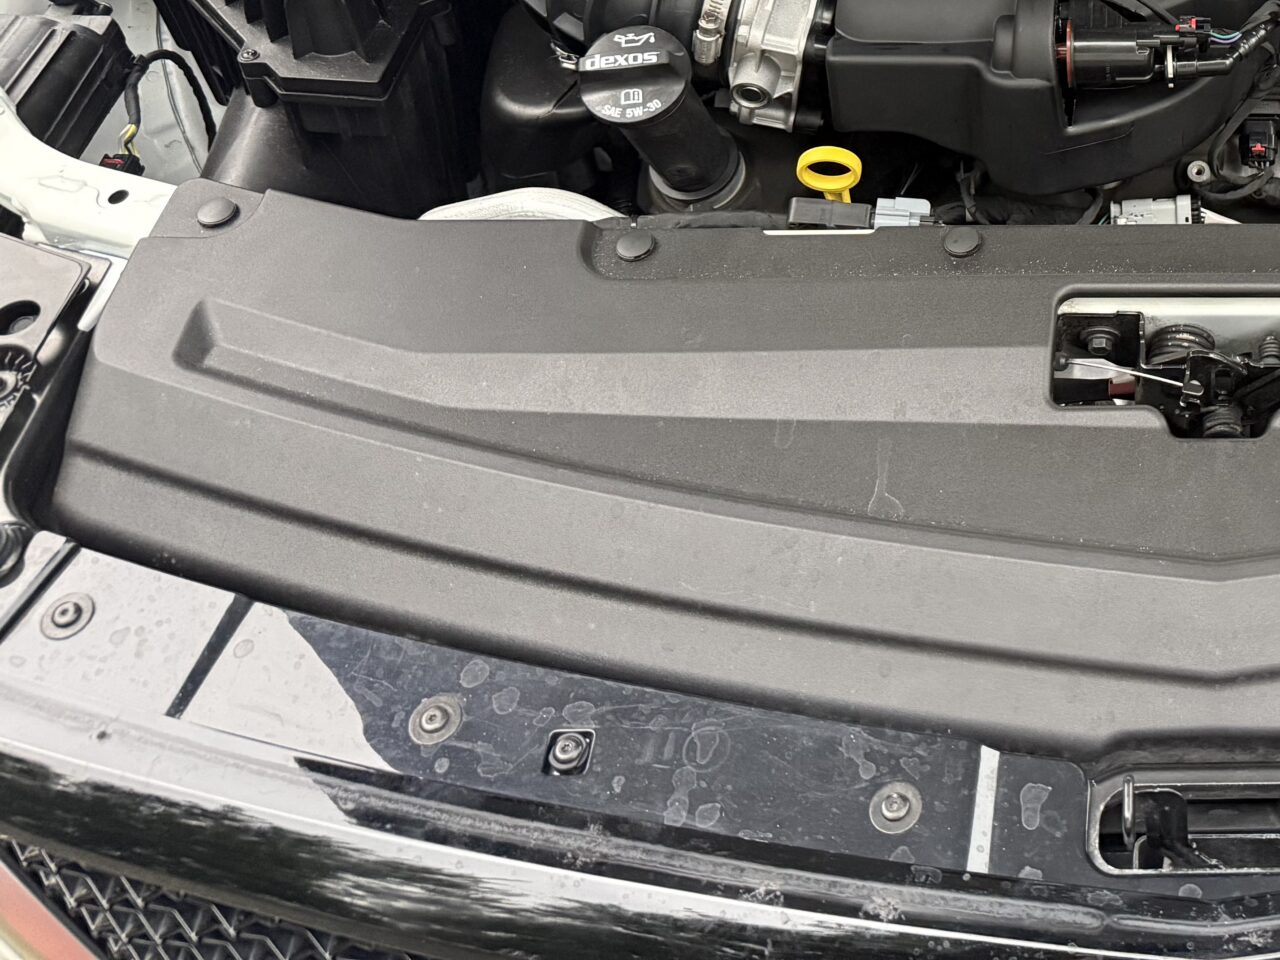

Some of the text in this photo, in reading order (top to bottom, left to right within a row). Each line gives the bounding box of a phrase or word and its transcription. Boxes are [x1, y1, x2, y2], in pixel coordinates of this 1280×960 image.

[585, 51, 661, 71] dexos
[601, 99, 662, 118] SAE 5W-30
